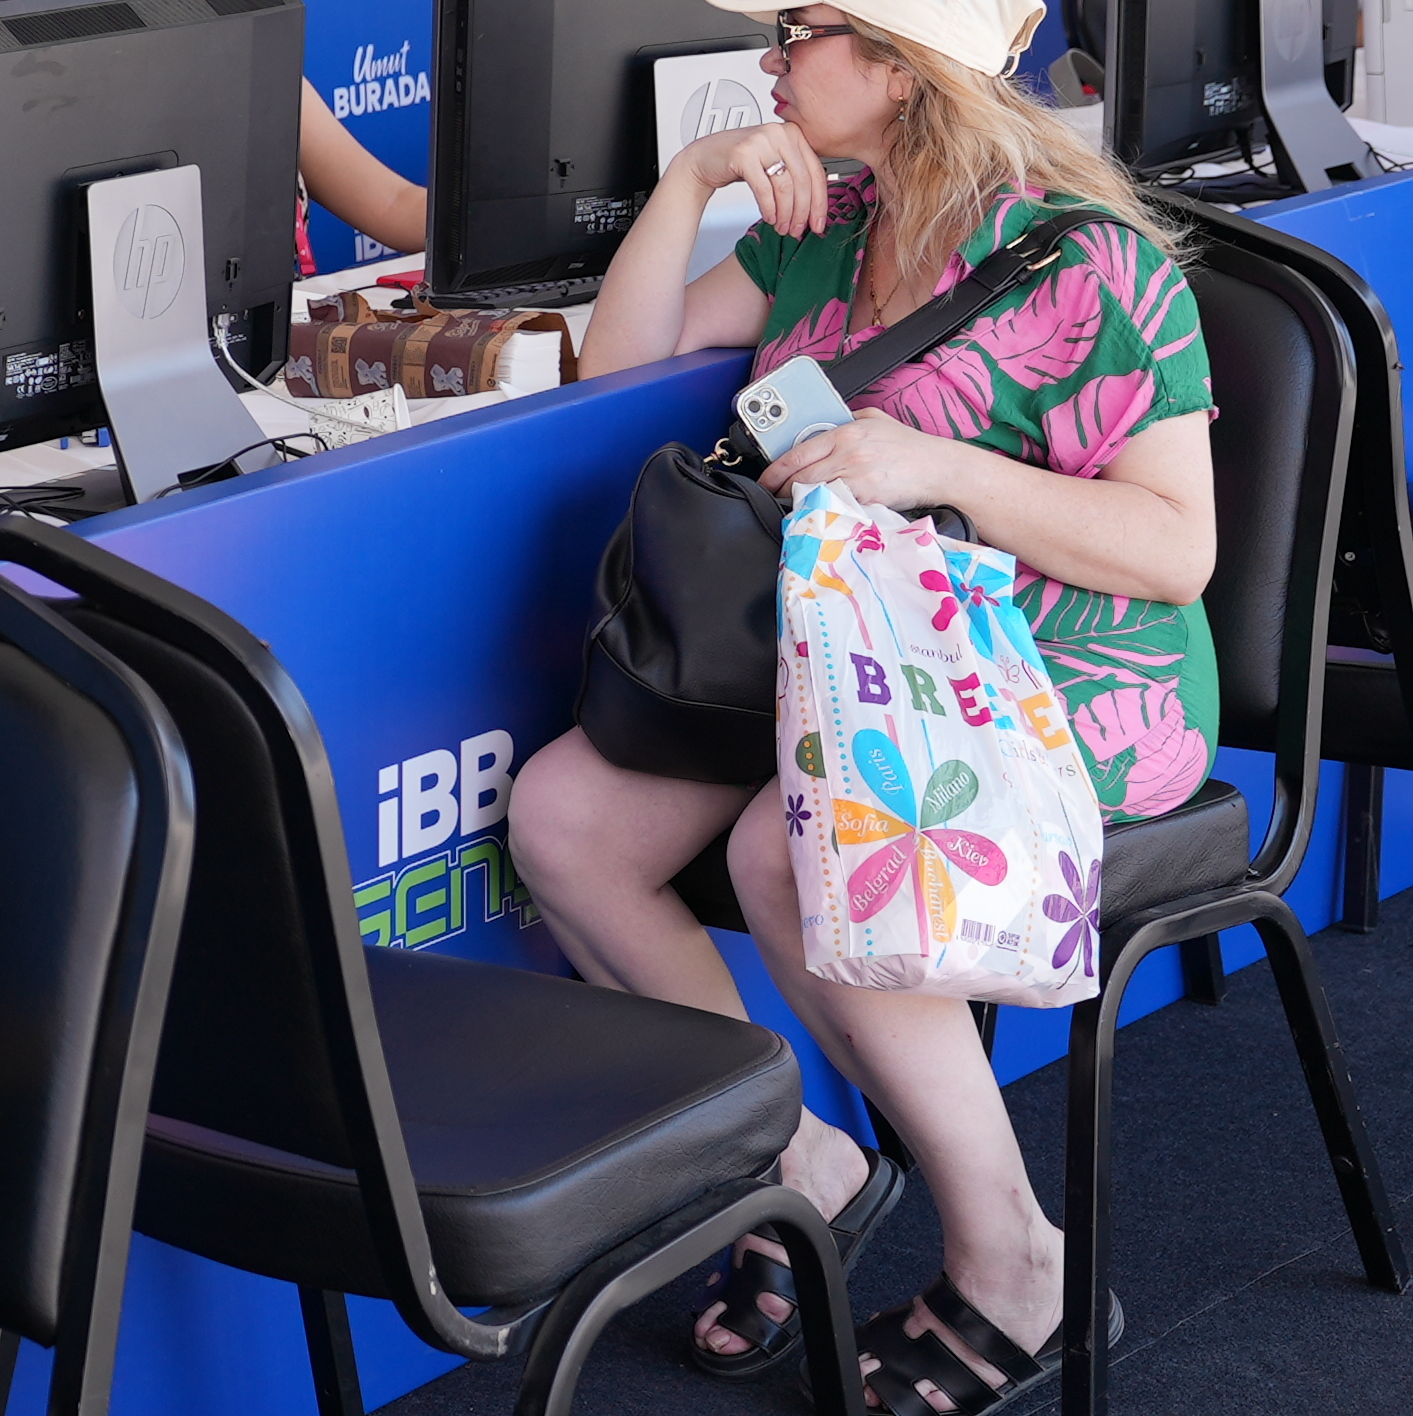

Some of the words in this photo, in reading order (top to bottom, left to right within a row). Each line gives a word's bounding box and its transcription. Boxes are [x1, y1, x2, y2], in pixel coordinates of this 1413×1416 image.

[353, 39, 411, 84] Umut
[333, 71, 432, 121] BURADA
[838, 812, 890, 837] Sofia
[946, 836, 990, 868] Kiev
[850, 844, 909, 913] Belgrad
